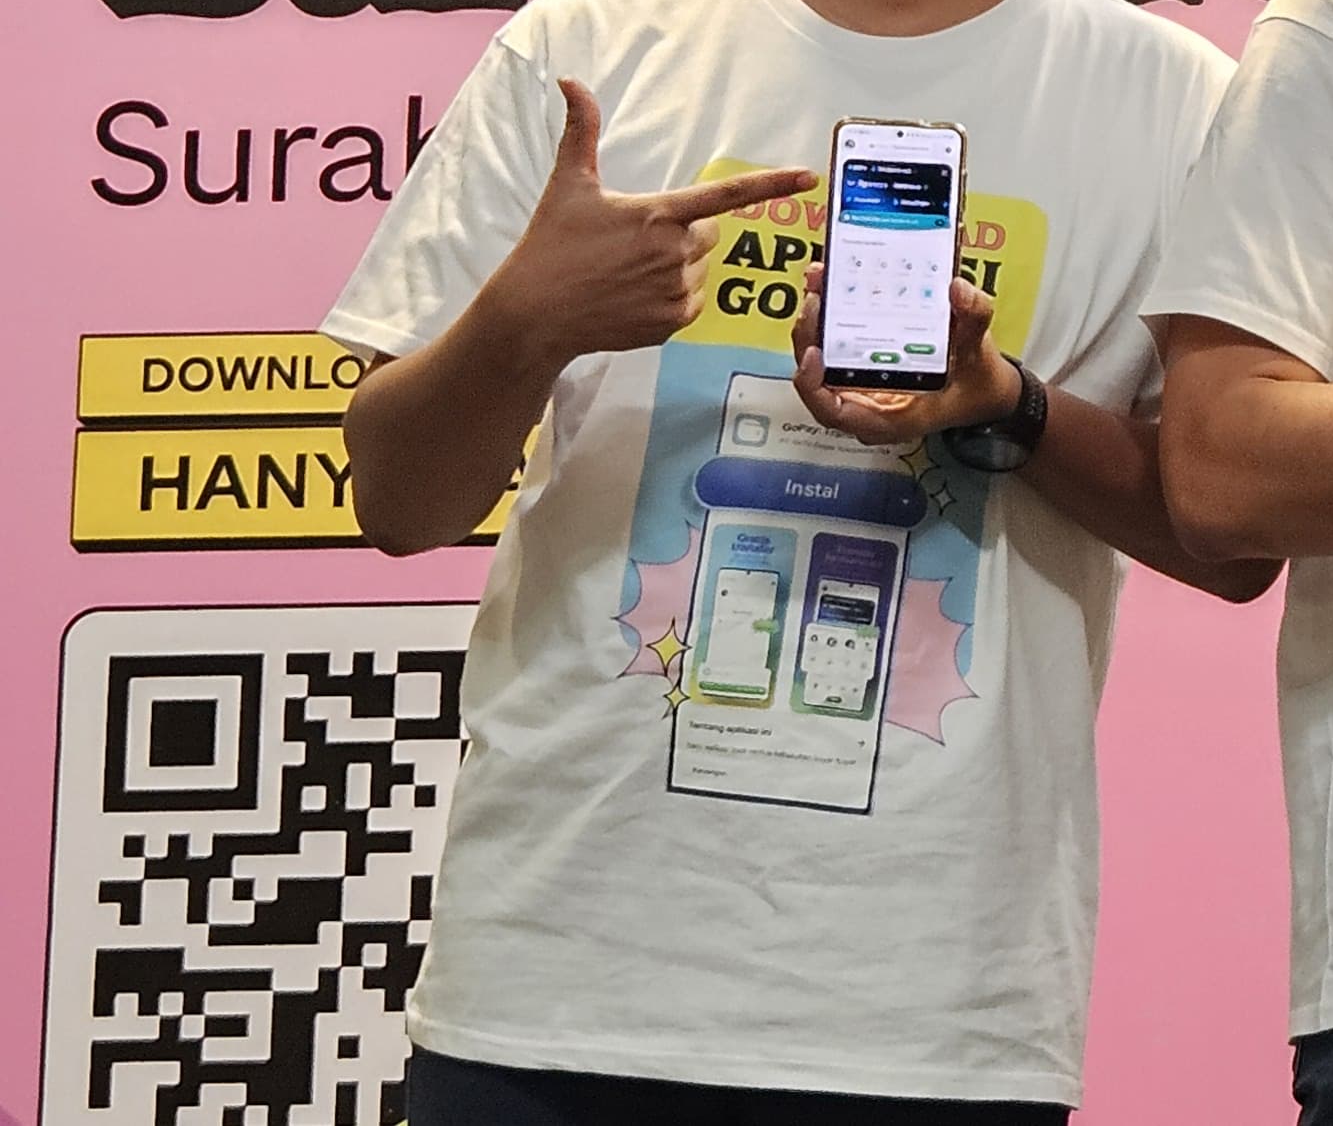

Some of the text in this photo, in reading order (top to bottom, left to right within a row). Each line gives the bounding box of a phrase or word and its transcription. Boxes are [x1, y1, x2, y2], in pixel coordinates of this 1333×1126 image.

[142, 355, 363, 393] DOWNLO
[138, 452, 350, 512] HANY
[785, 478, 840, 499] Instal
